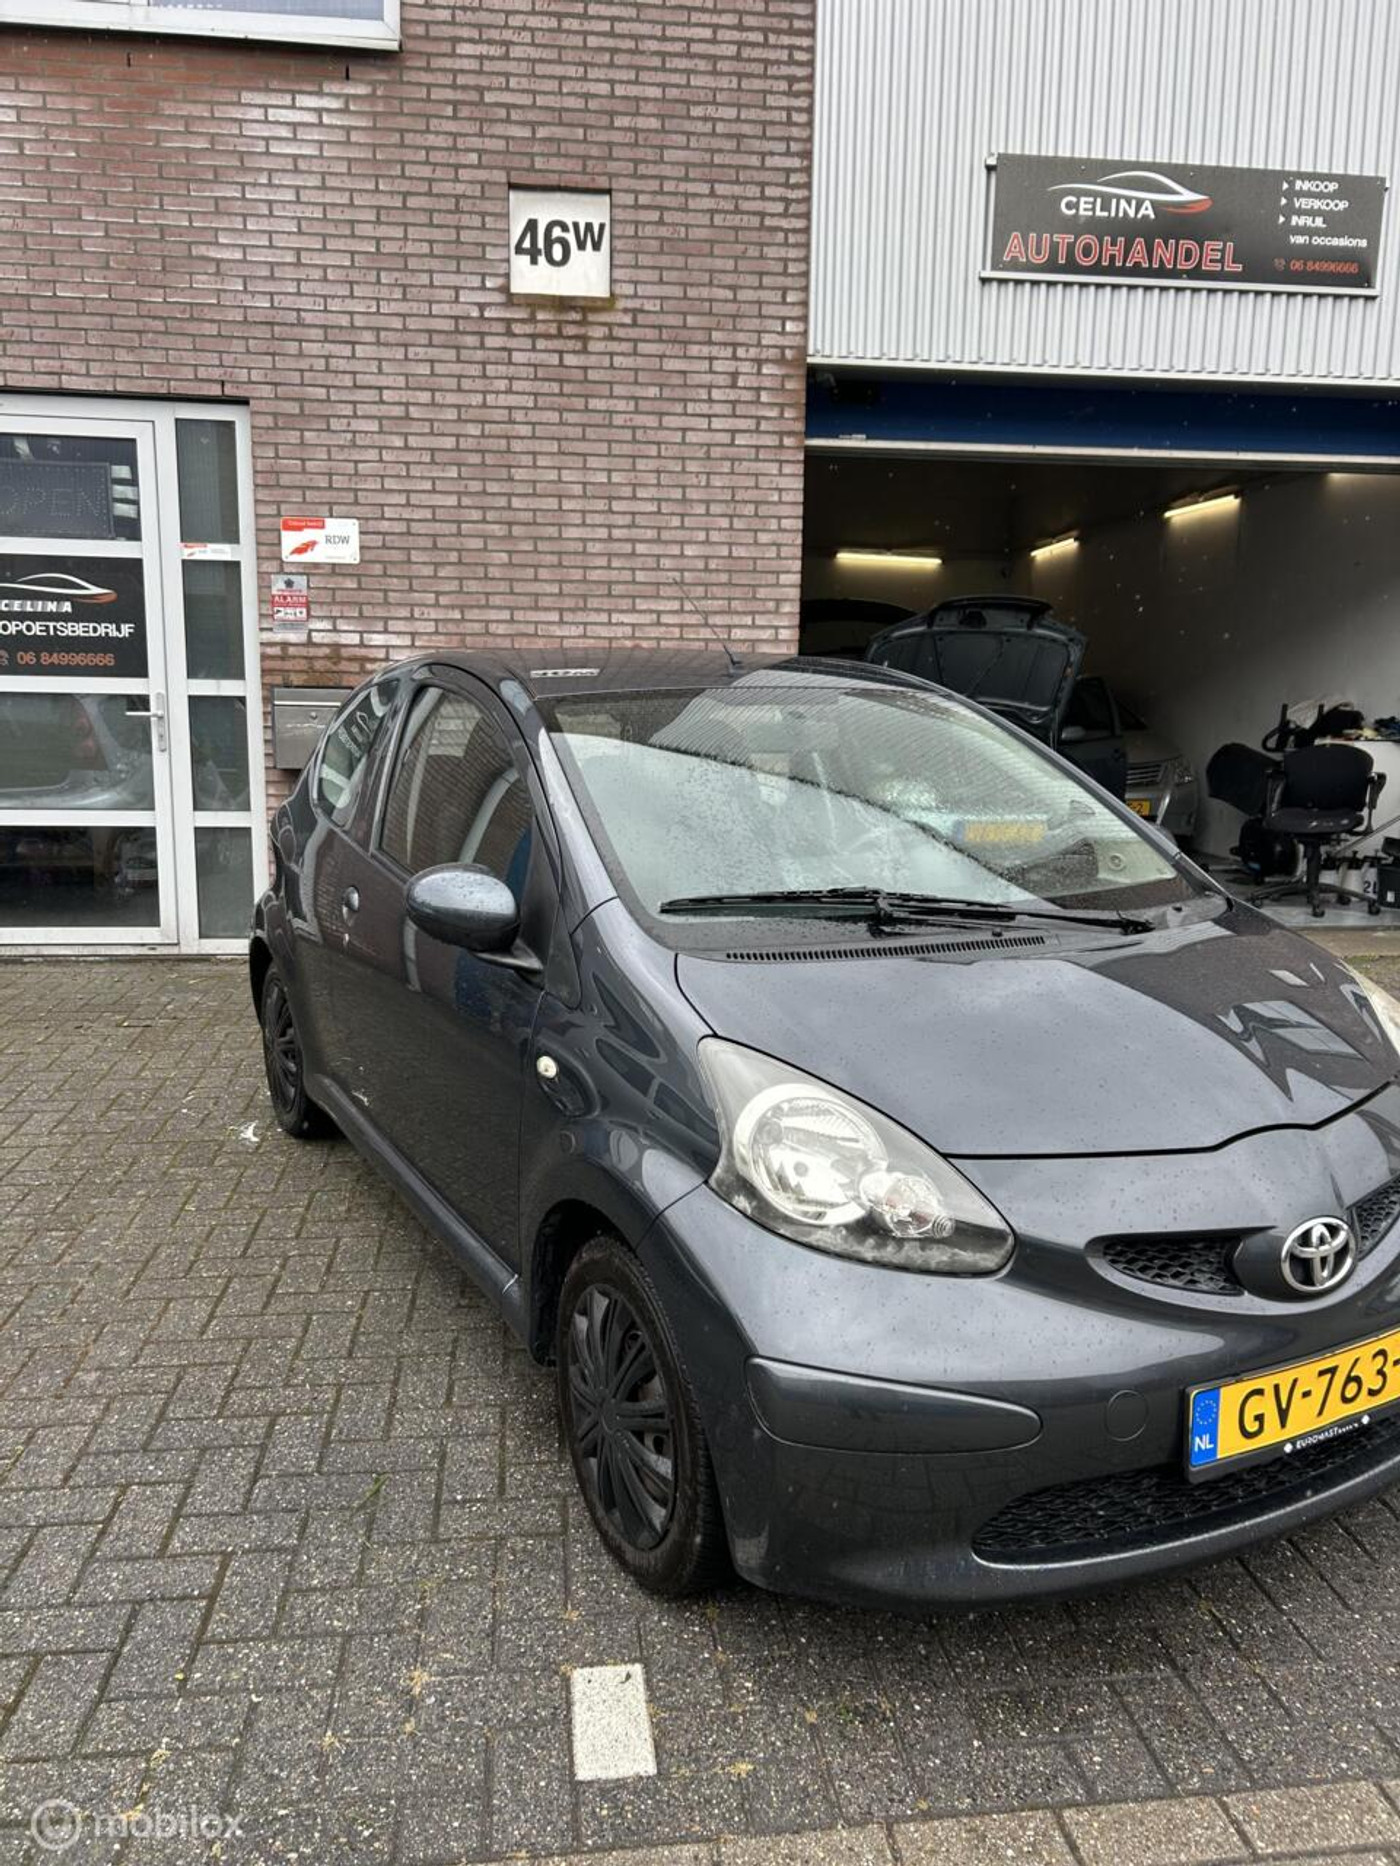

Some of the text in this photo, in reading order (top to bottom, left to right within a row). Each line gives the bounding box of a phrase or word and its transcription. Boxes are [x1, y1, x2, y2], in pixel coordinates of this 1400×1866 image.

[1294, 180, 1339, 193] INKOOP
[1060, 195, 1156, 219] CELINA
[1293, 197, 1349, 211] VERKOOP
[1290, 214, 1327, 228] INRUIL
[1289, 234, 1368, 248] van occasions
[1003, 231, 1243, 272] AUTOHANDEL
[1290, 259, 1304, 271] 06
[325, 535, 351, 545] RDW
[1, 599, 72, 613] CELINA
[17, 651, 115, 666] 06 84996666
[1194, 1433, 1214, 1452] NL
